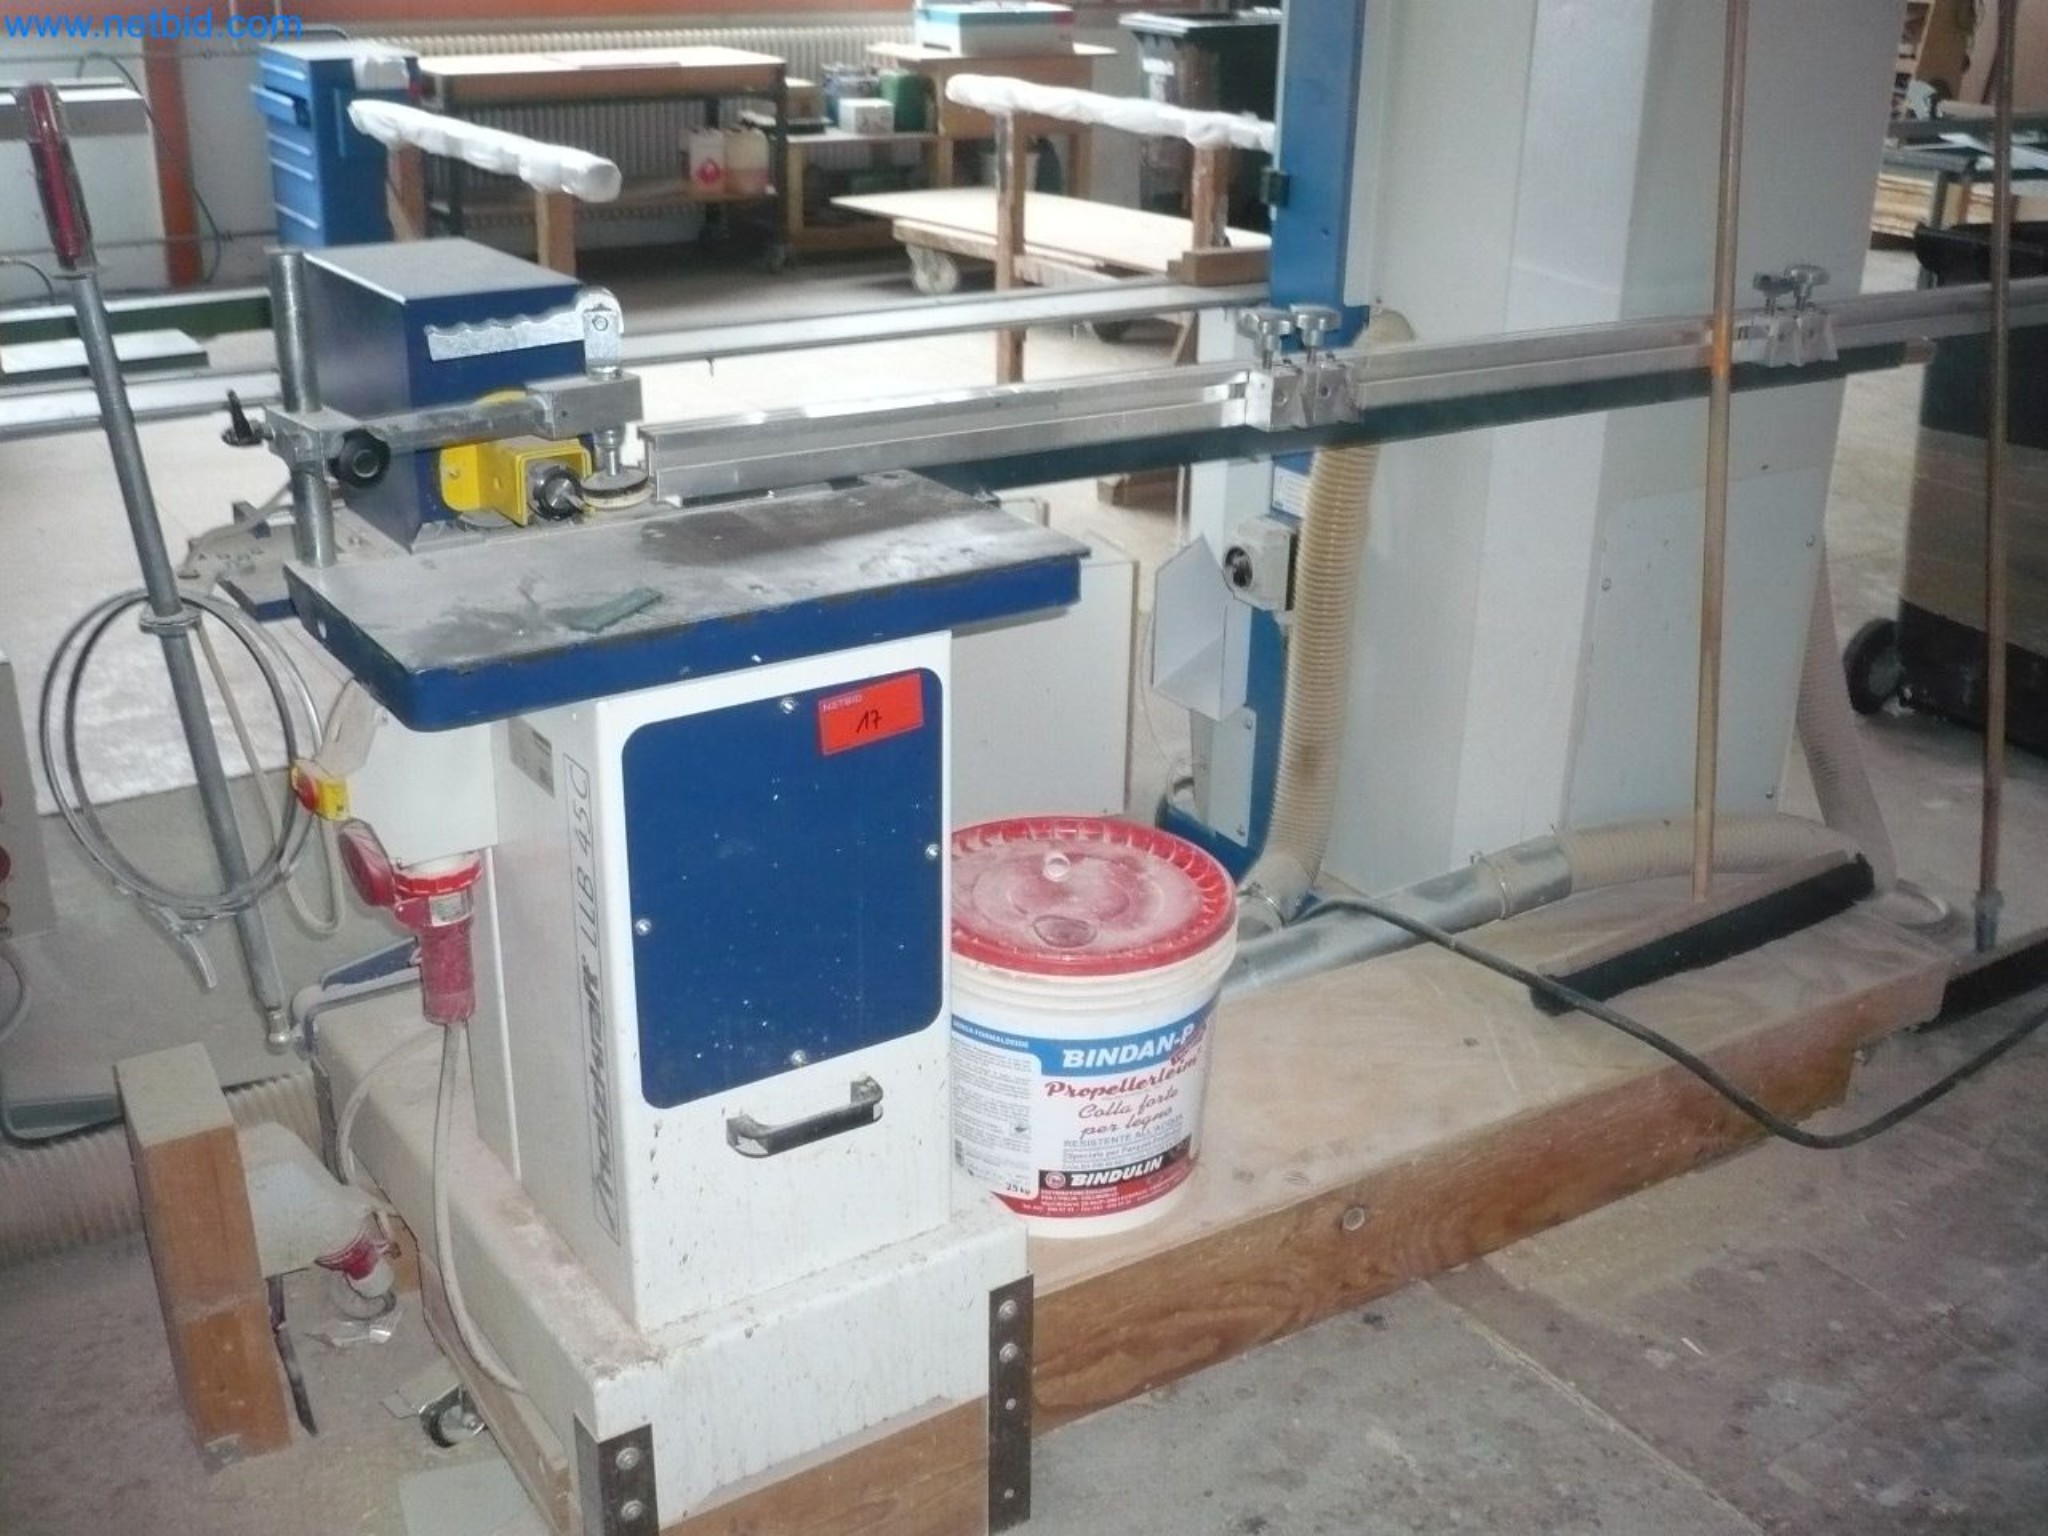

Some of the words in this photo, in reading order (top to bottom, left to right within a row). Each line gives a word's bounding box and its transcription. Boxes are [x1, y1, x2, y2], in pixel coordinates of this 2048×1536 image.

[856, 708, 883, 734] 17
[576, 866, 598, 949] LLB
[1062, 1022, 1195, 1068] BINDAN-P
[1070, 1155, 1164, 1187] BINDULIN
